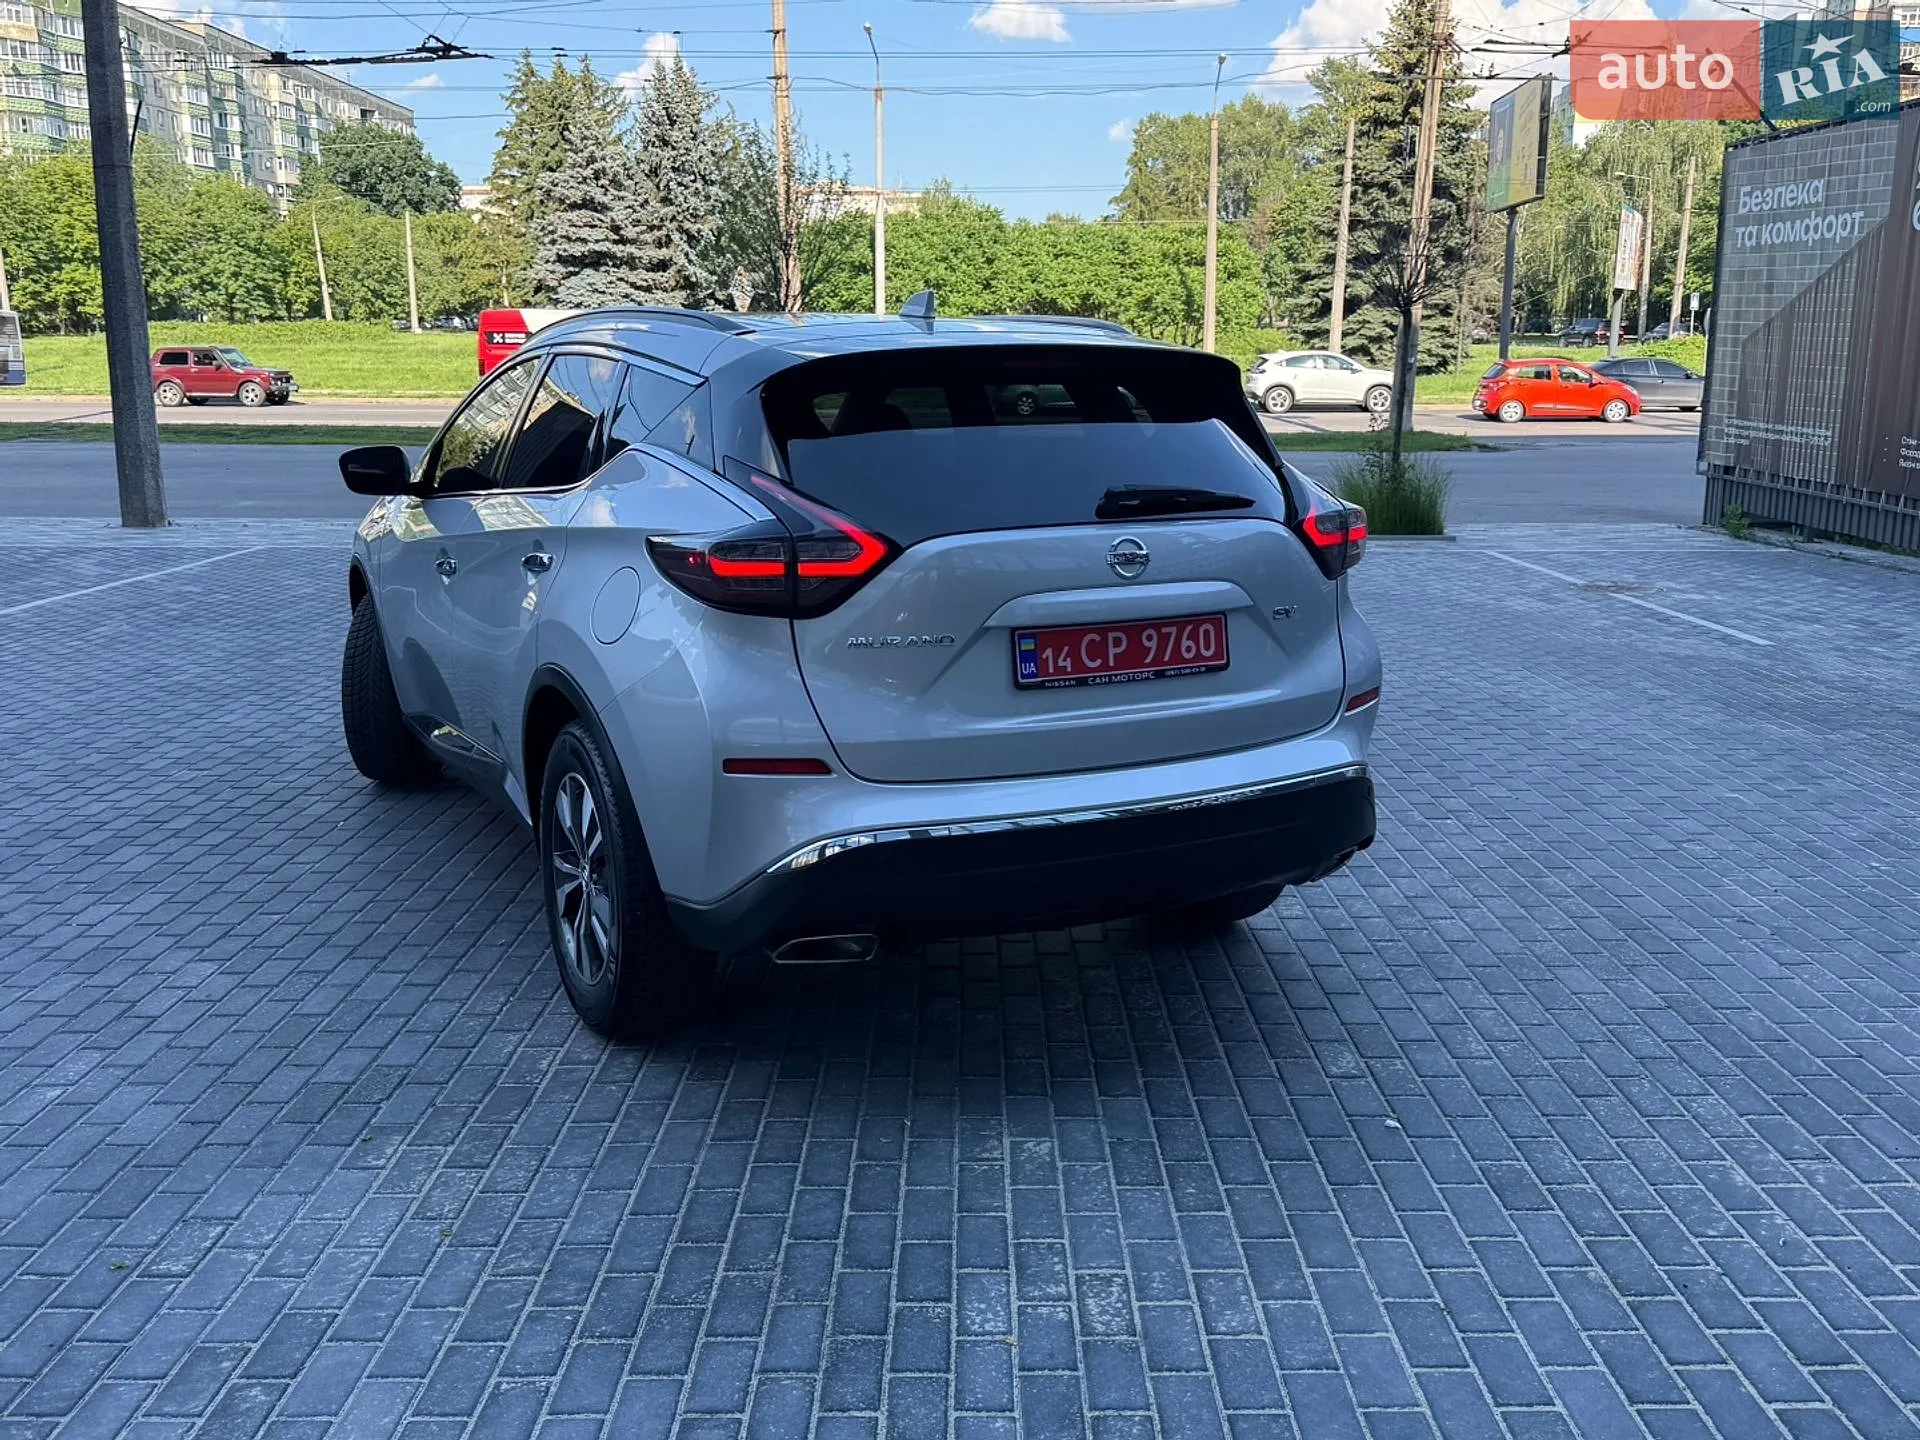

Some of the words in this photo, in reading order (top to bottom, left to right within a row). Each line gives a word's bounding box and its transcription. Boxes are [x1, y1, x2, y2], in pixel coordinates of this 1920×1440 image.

[1738, 179, 1824, 214] Безпека
[1736, 225, 1757, 248] та
[1761, 210, 1864, 247] комфорт
[847, 634, 955, 649] MURANO
[1041, 646, 1071, 673] 14
[1142, 623, 1215, 663] 9760
[1022, 663, 1036, 674] UA
